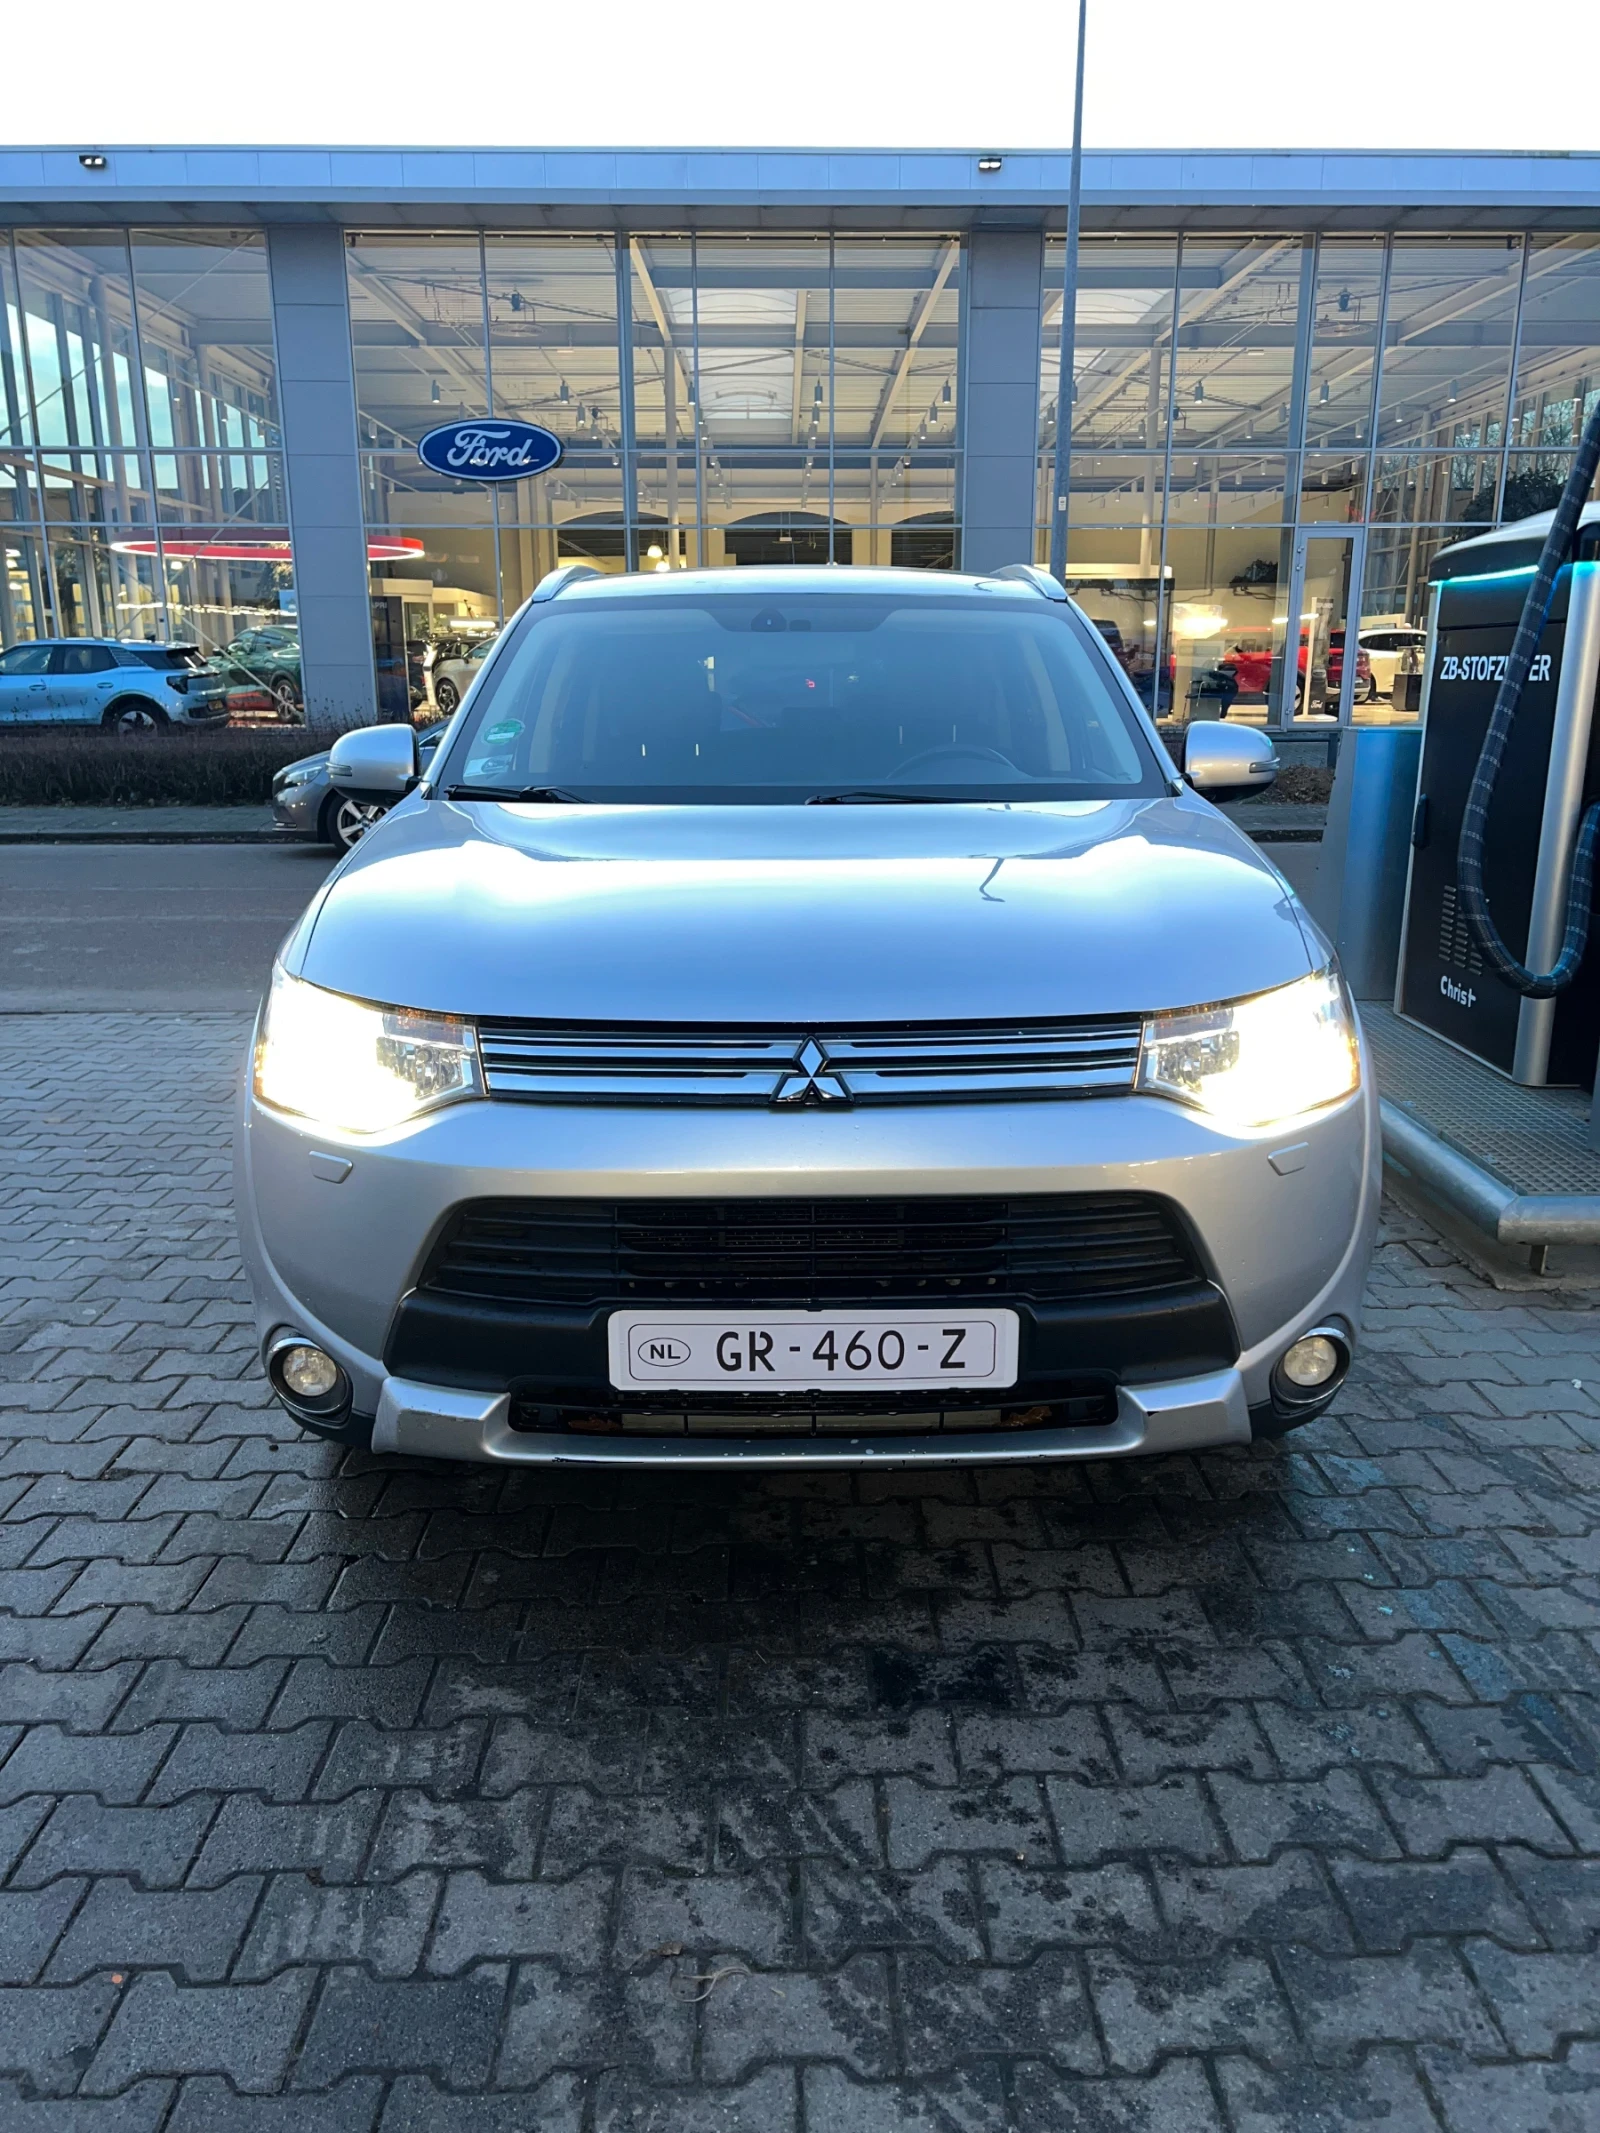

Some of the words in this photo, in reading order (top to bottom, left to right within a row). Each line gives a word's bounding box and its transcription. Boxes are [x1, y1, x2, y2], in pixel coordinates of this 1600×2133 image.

[447, 429, 532, 466] Ford
[1440, 655, 1551, 681] ZB-STOFZER
[1440, 975, 1477, 1008] Christ
[650, 1344, 681, 1360] NL
